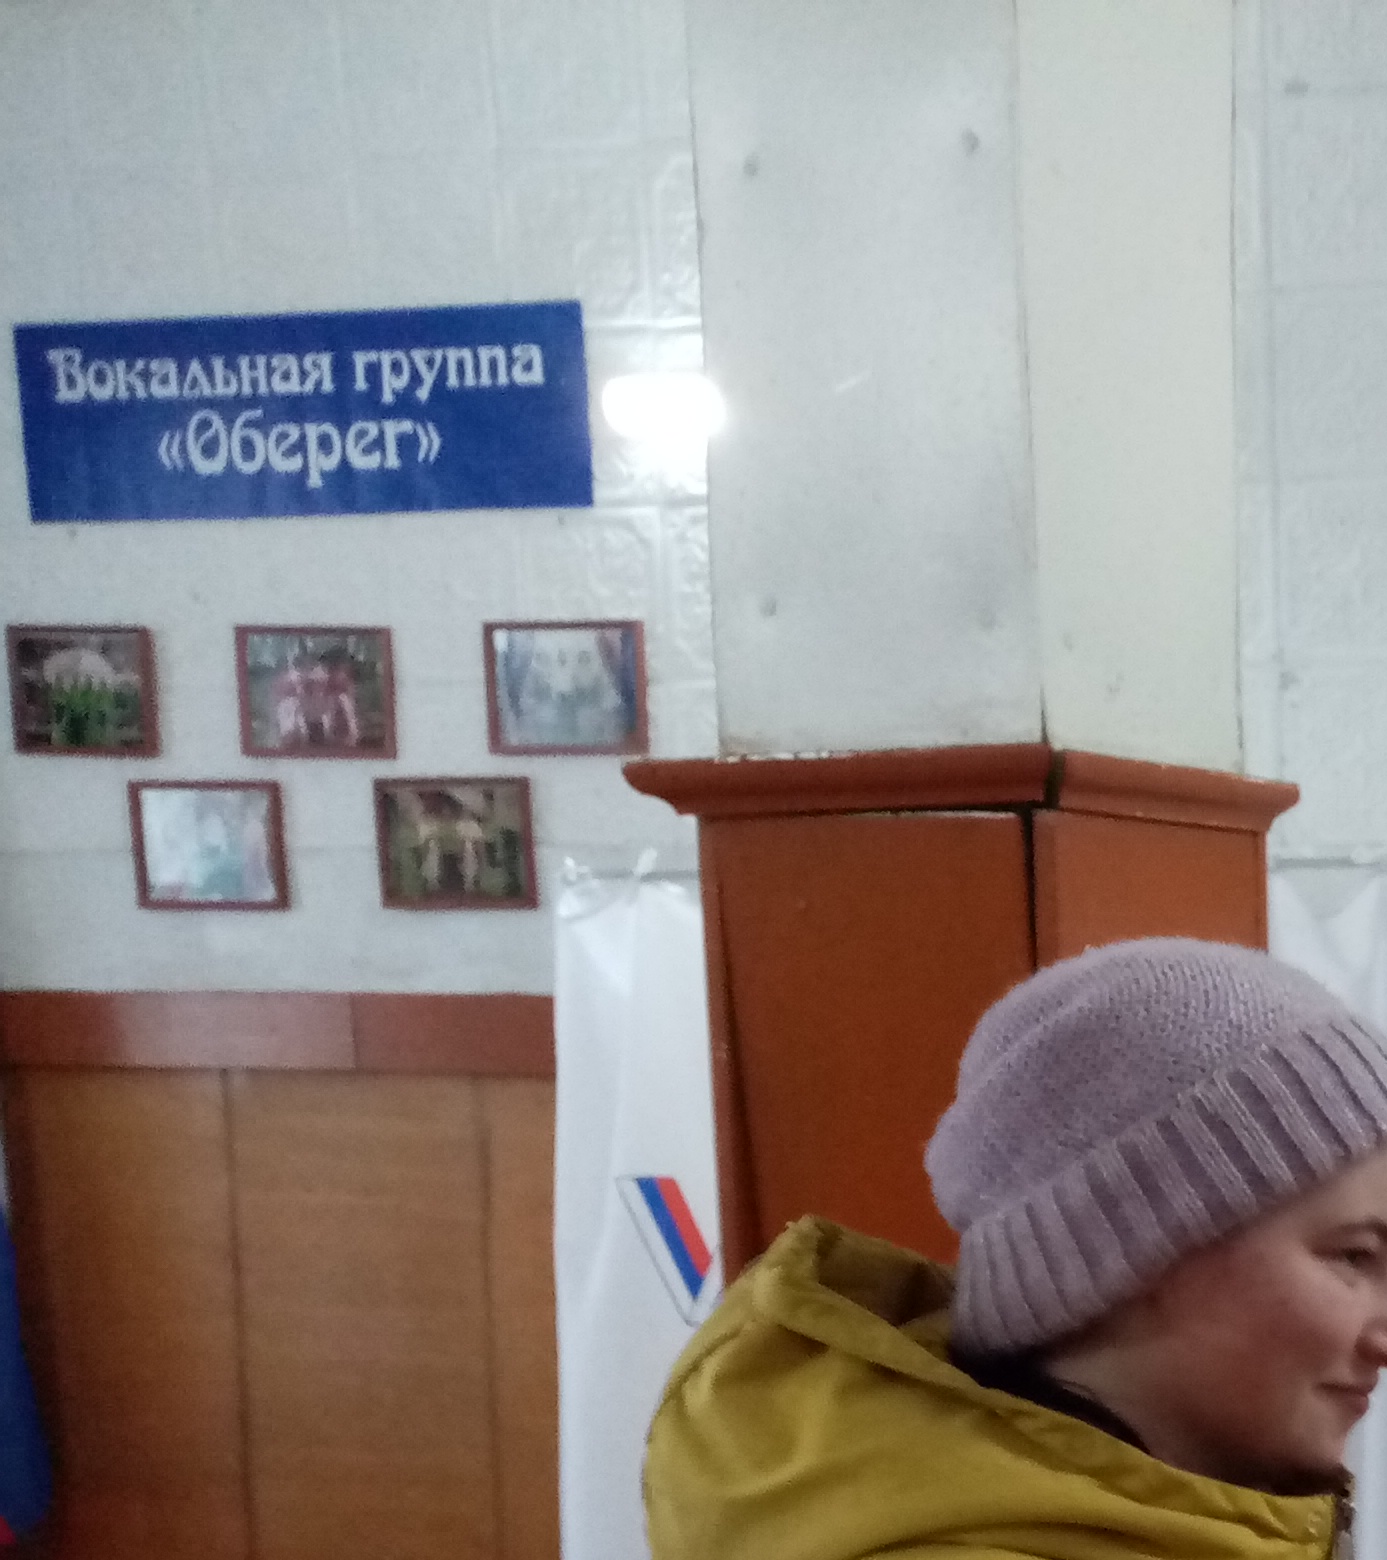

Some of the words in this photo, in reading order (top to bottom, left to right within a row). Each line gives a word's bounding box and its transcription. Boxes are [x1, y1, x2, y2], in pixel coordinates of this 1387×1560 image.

[46, 346, 335, 404] Вокальная
[352, 343, 545, 404] группа
[157, 409, 442, 489] «Оберег»
